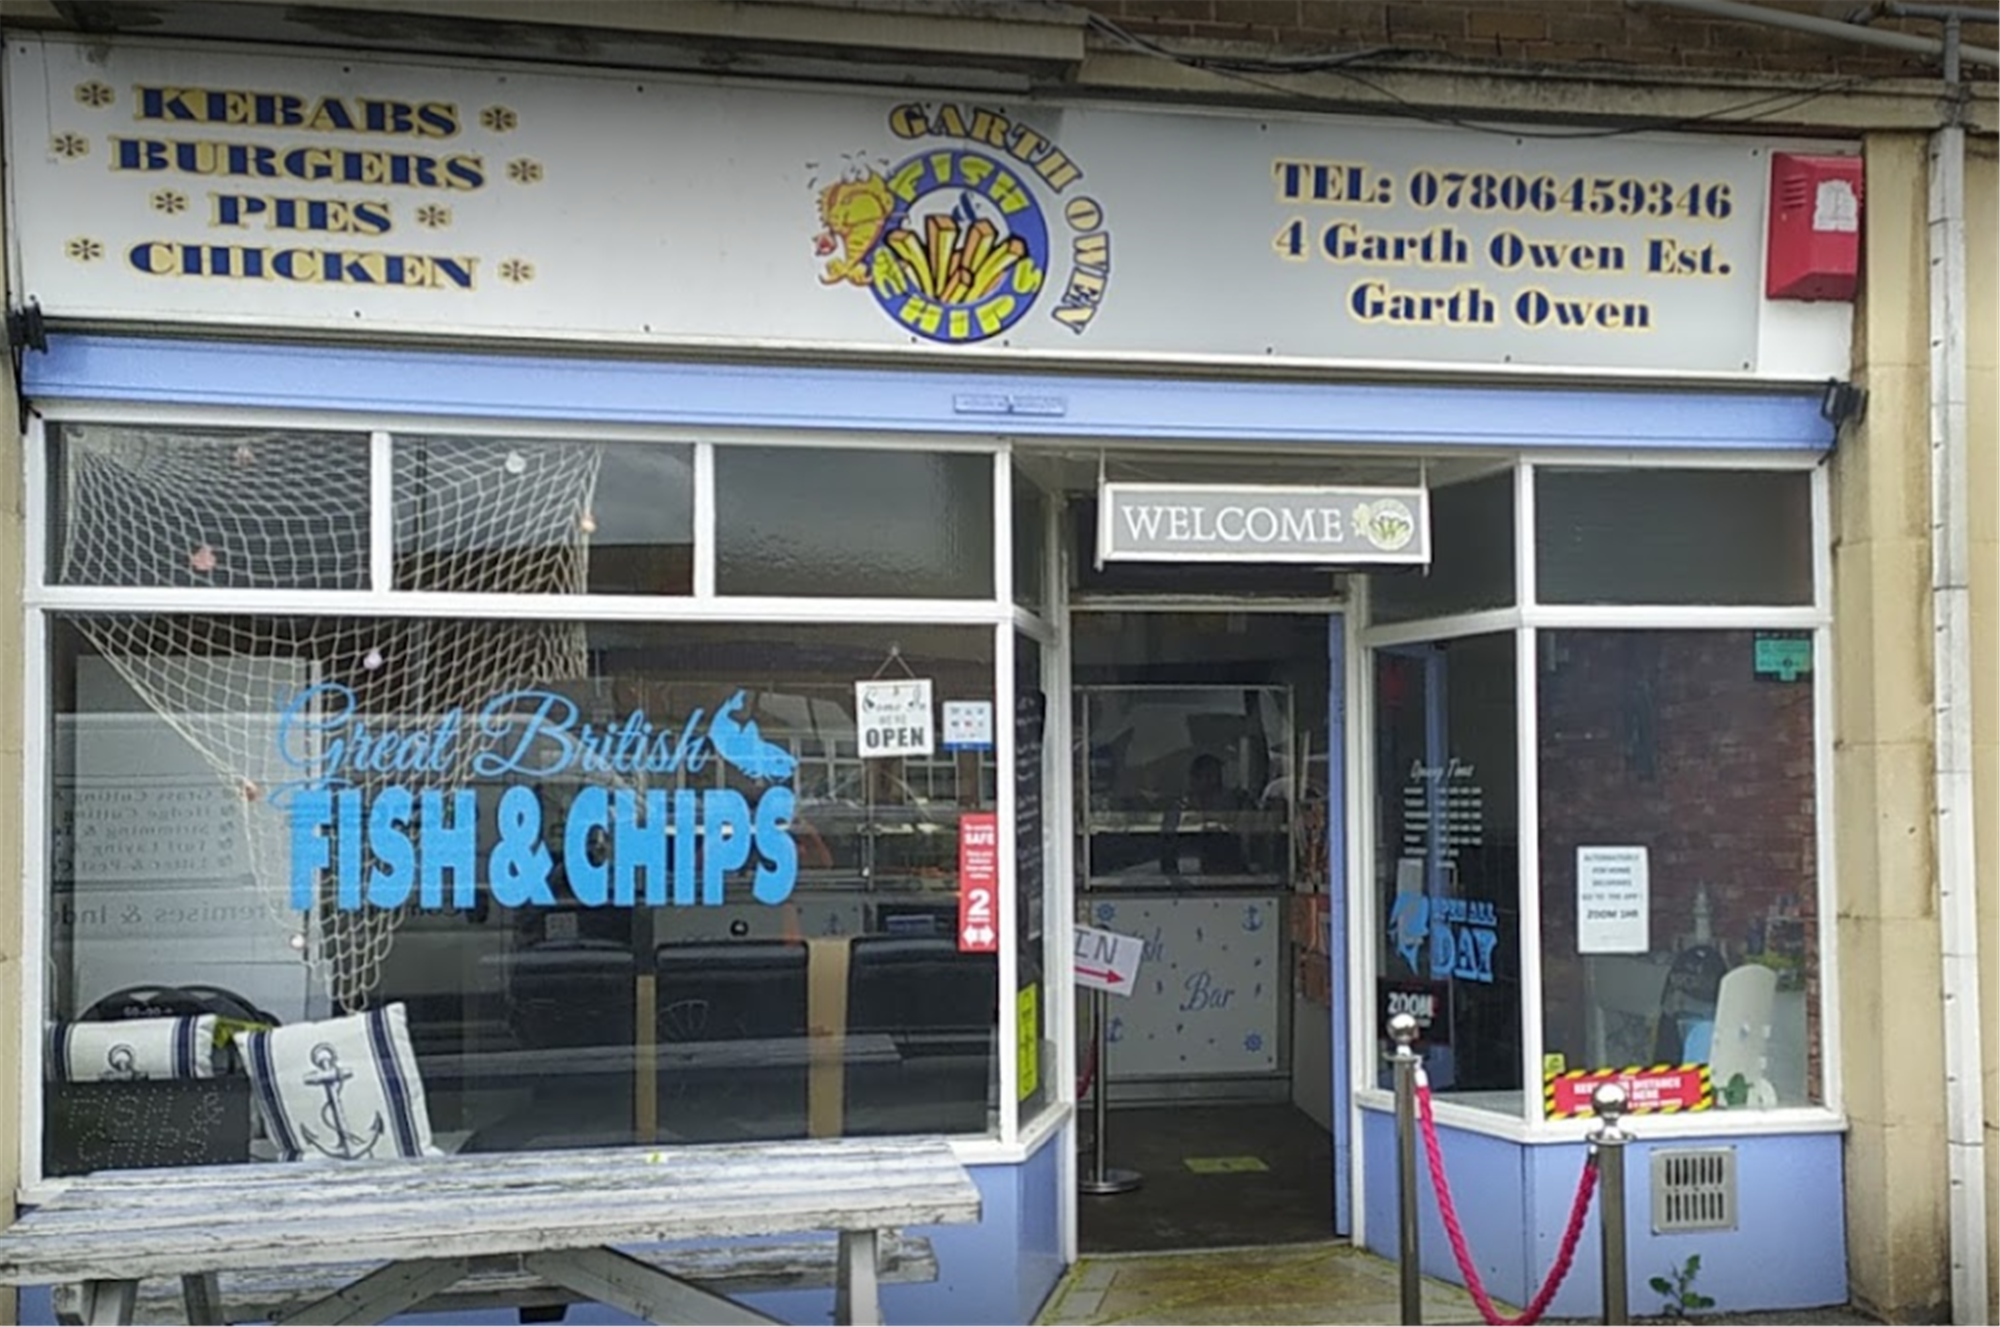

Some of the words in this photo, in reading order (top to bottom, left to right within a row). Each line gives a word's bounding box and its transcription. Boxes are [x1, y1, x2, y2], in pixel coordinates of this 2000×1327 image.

[133, 84, 460, 138] KEBABS
[108, 136, 485, 191] BURGERS
[888, 152, 1030, 214] FISH
[208, 192, 391, 236] PIES
[889, 102, 1084, 193] GARTH
[1052, 196, 1110, 334] OWEN
[1275, 162, 1392, 205] TEL:
[1410, 170, 1732, 220] 07806459346
[130, 241, 479, 291] CHICKEN
[1275, 221, 1307, 258] 4
[1324, 222, 1468, 265] Garth
[1490, 232, 1626, 273] Owen
[1647, 240, 1731, 277] Est.
[872, 247, 1043, 339] CHIPS
[1351, 282, 1495, 325] Garth
[1515, 290, 1651, 329] Owen
[1122, 506, 1343, 543] WELCOME
[270, 683, 463, 808] Great
[473, 690, 710, 777] British
[866, 727, 925, 748] OPEN
[289, 785, 476, 909] FISH
[489, 785, 558, 907] &
[564, 785, 798, 907] CHIPS
[968, 887, 991, 916] 2
[1430, 923, 1498, 983] DAY
[1179, 969, 1236, 1012] Bar
[1388, 991, 1435, 1018] ZOOM
